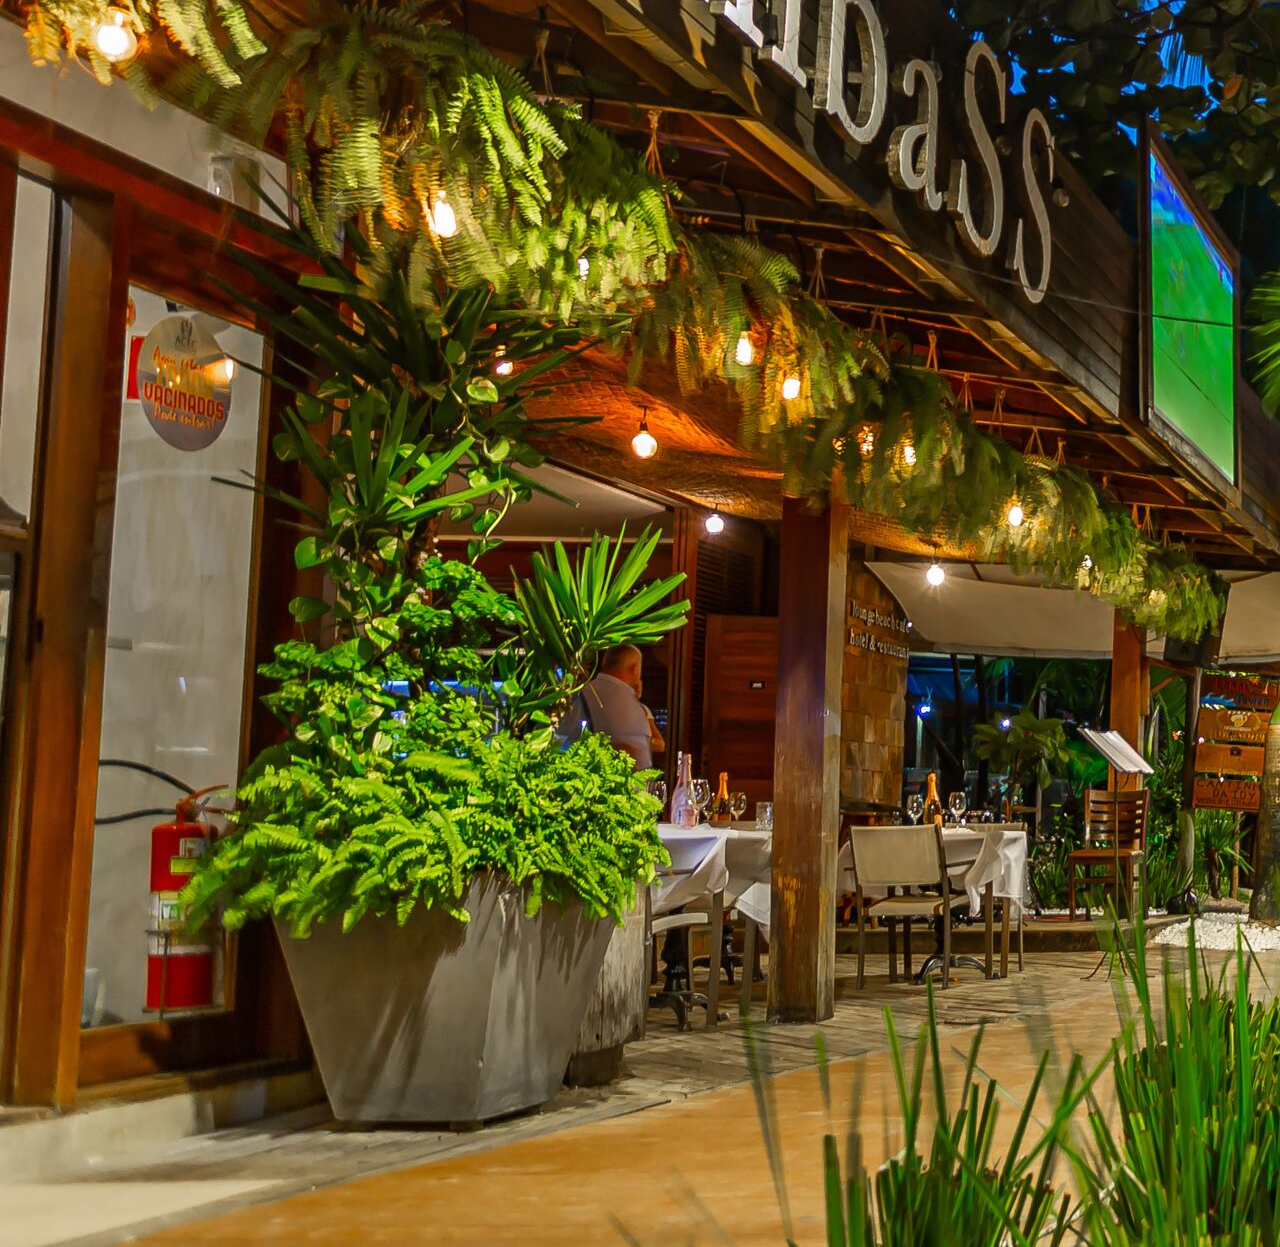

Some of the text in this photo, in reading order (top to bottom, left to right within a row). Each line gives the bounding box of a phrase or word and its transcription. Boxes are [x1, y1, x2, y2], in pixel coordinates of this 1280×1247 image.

[143, 381, 224, 420] VACINADOS
[850, 628, 869, 649] hotel
[869, 634, 876, 651] &
